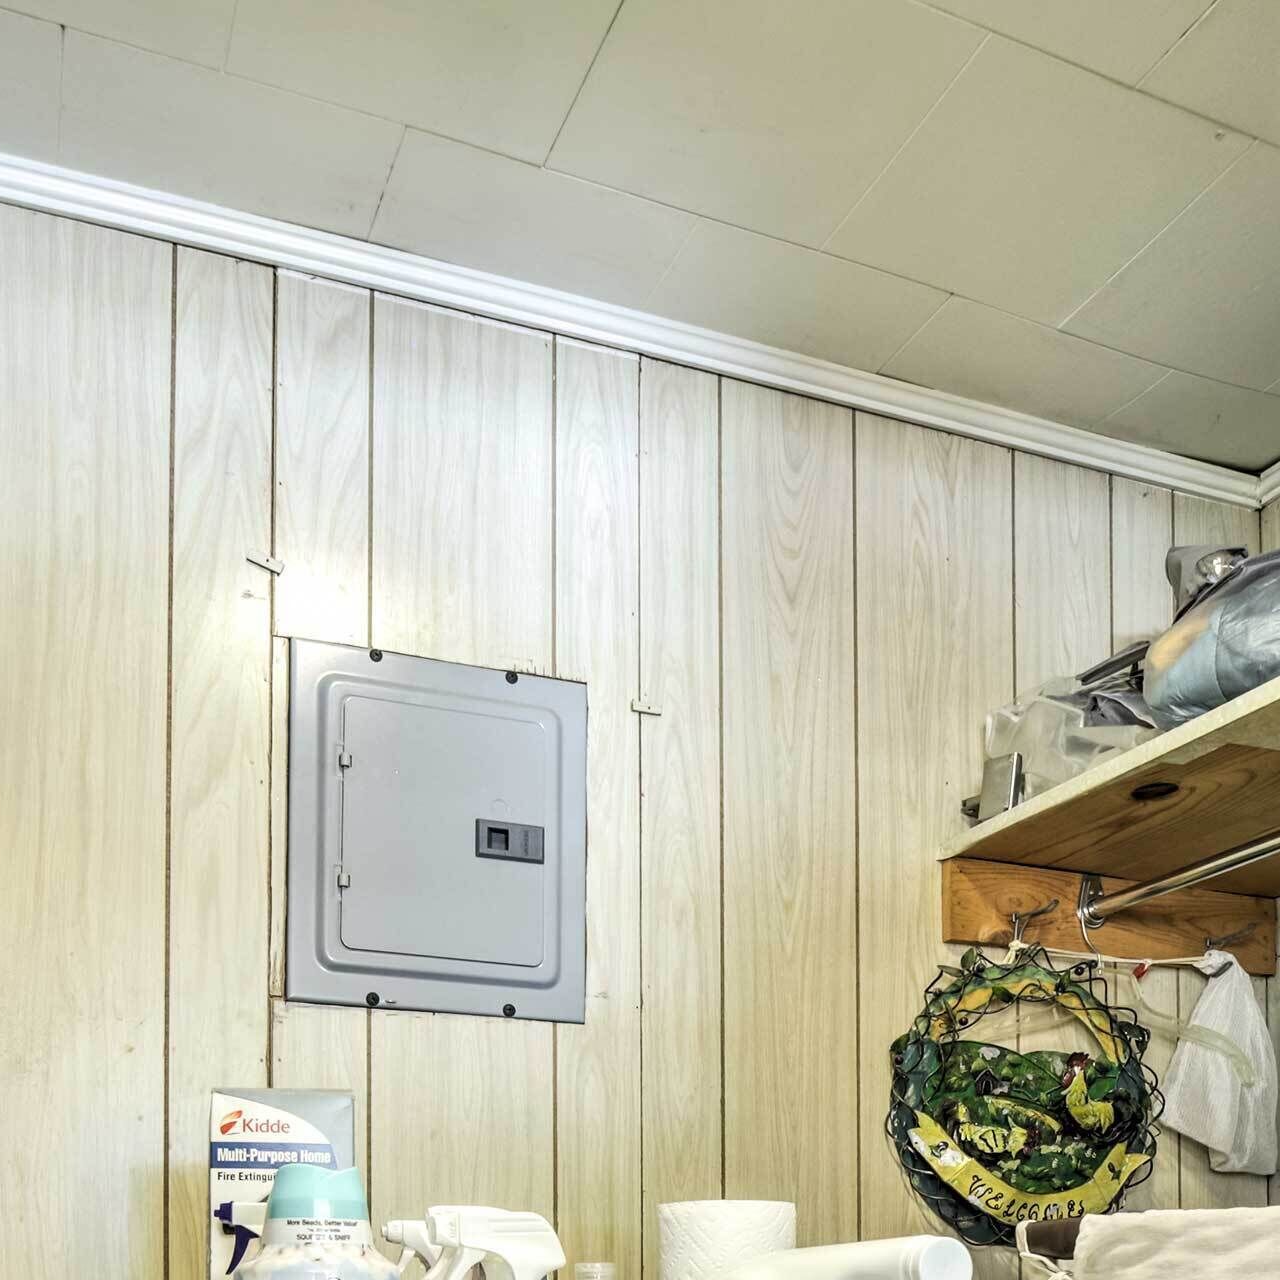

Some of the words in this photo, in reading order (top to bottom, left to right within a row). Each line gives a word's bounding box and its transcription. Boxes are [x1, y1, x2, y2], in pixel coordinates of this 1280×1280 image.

[242, 1118, 291, 1134] Kidde
[217, 1147, 298, 1164] Multi-Purpose
[300, 1150, 332, 1163] Home
[217, 1172, 236, 1181] Fire
[238, 1172, 276, 1182] Extingui
